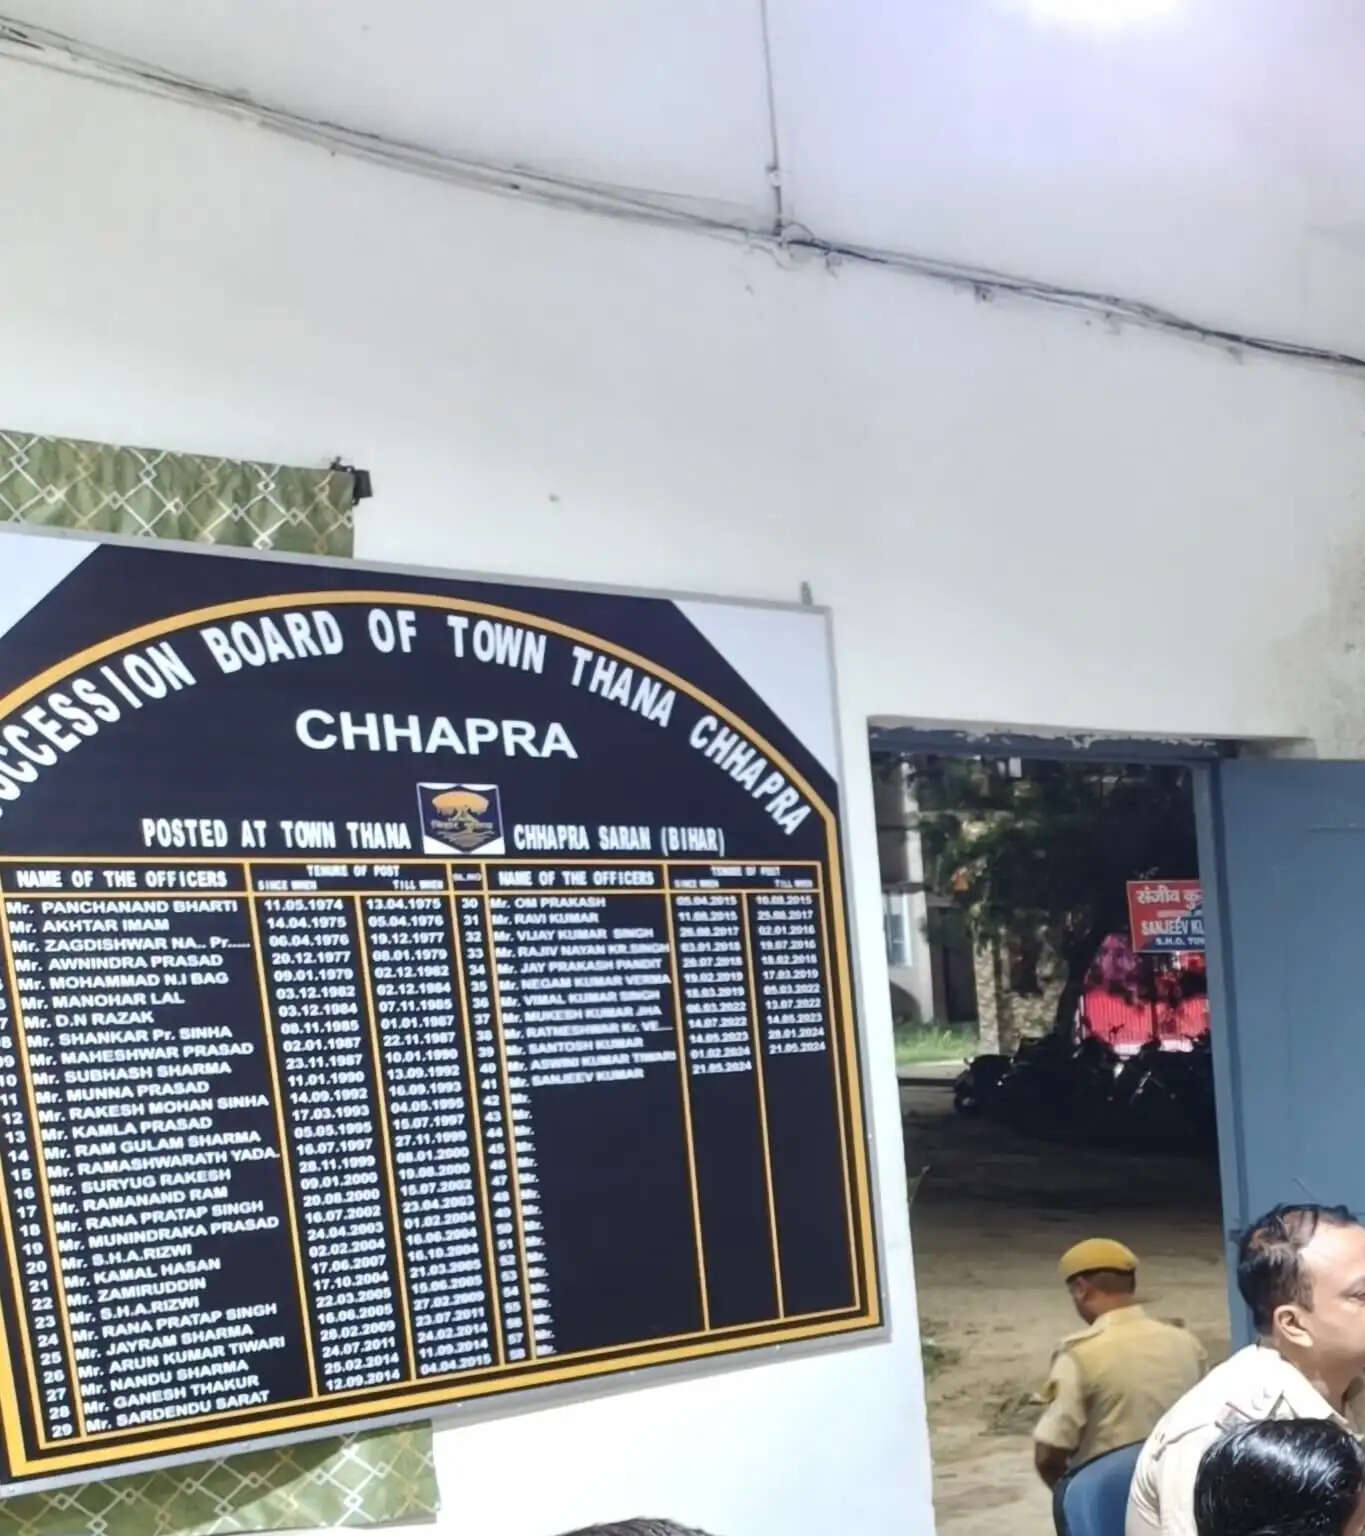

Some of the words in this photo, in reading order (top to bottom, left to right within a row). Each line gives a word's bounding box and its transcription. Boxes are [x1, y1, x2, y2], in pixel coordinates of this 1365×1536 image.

[0, 641, 197, 818] CCESSION
[200, 610, 344, 674] BOARD
[368, 608, 417, 654] OF
[447, 614, 547, 674] TOWN
[571, 645, 677, 728] THANA
[689, 714, 813, 836] CHHAPRA
[295, 709, 578, 760] CHHAPRA
[141, 818, 228, 848] POSTED
[240, 819, 267, 849] AT
[280, 820, 336, 849] TOWN
[346, 821, 412, 850] THANA
[513, 823, 590, 851] CHHAPRA
[598, 824, 651, 851] SARAN
[661, 825, 725, 857] (BIHAR)
[16, 870, 62, 888] NAME
[71, 870, 94, 888] OF
[103, 870, 137, 888] THE
[145, 870, 228, 888] OFFICERS
[498, 870, 532, 886] NAME
[538, 870, 556, 886] OF
[562, 870, 586, 886] THE
[594, 870, 654, 886] OFFICERS
[7, 901, 34, 914] Mr.
[41, 900, 170, 914] PANCHANAND
[172, 900, 238, 913] BHARTI
[264, 899, 344, 911] 11.05.1974
[366, 898, 442, 910] 13.04.1975
[461, 898, 478, 909] 30
[539, 895, 606, 908] PRAKASH
[266, 916, 347, 929] 14.04.1975
[367, 914, 444, 928] 05.04.1976
[463, 914, 479, 926] 31
[513, 913, 547, 925] RAVI
[548, 912, 599, 925] KUMAR
[9, 920, 37, 934] Mr.
[42, 918, 119, 933] AKHTAR
[121, 918, 170, 932] IMAM
[268, 933, 350, 947] 06.04.1976
[370, 931, 444, 945] 19.12.1977
[465, 930, 482, 943] 32
[18, 977, 46, 991] Mr.
[49, 973, 161, 990] MOHAMMAD
[189, 971, 229, 985] BAG
[21, 996, 48, 1010] Mr.
[51, 992, 147, 1008] MANOHAR
[149, 991, 185, 1005] LAL
[24, 1015, 52, 1029] Mr.
[91, 1010, 155, 1026] RAZAK
[27, 1035, 55, 1048] Mr.
[58, 1029, 149, 1046] SHANKAR
[178, 1025, 233, 1040] SINHA
[38, 1109, 66, 1123] Mr.
[68, 1103, 145, 1120] RAKESH
[147, 1098, 214, 1115] MOHAN
[216, 1094, 270, 1110] SINHA
[2, 1111, 24, 1125] 12
[4, 1130, 26, 1144] 13
[44, 1146, 71, 1160] Mr.
[74, 1141, 117, 1157] RAM
[119, 1136, 185, 1154] GULAM
[187, 1130, 262, 1148] SHARMA
[7, 1149, 29, 1161] 14
[61, 1256, 88, 1270] Mr.
[64, 1275, 90, 1288] Mr.
[93, 1265, 158, 1285] KAMAL
[160, 1257, 221, 1276] HASAN
[67, 1293, 93, 1306] Mr.
[97, 1277, 206, 1303] ZAMIRUDDIN
[78, 1365, 104, 1378] Mr.
[108, 1354, 160, 1374] ARUN
[162, 1345, 226, 1365] KUMAR
[228, 1336, 285, 1355] TIWARI
[86, 1418, 112, 1432] Mr.
[116, 1399, 212, 1427] SARDENDU
[215, 1390, 270, 1410] SARAT
[51, 1423, 73, 1437] 29
